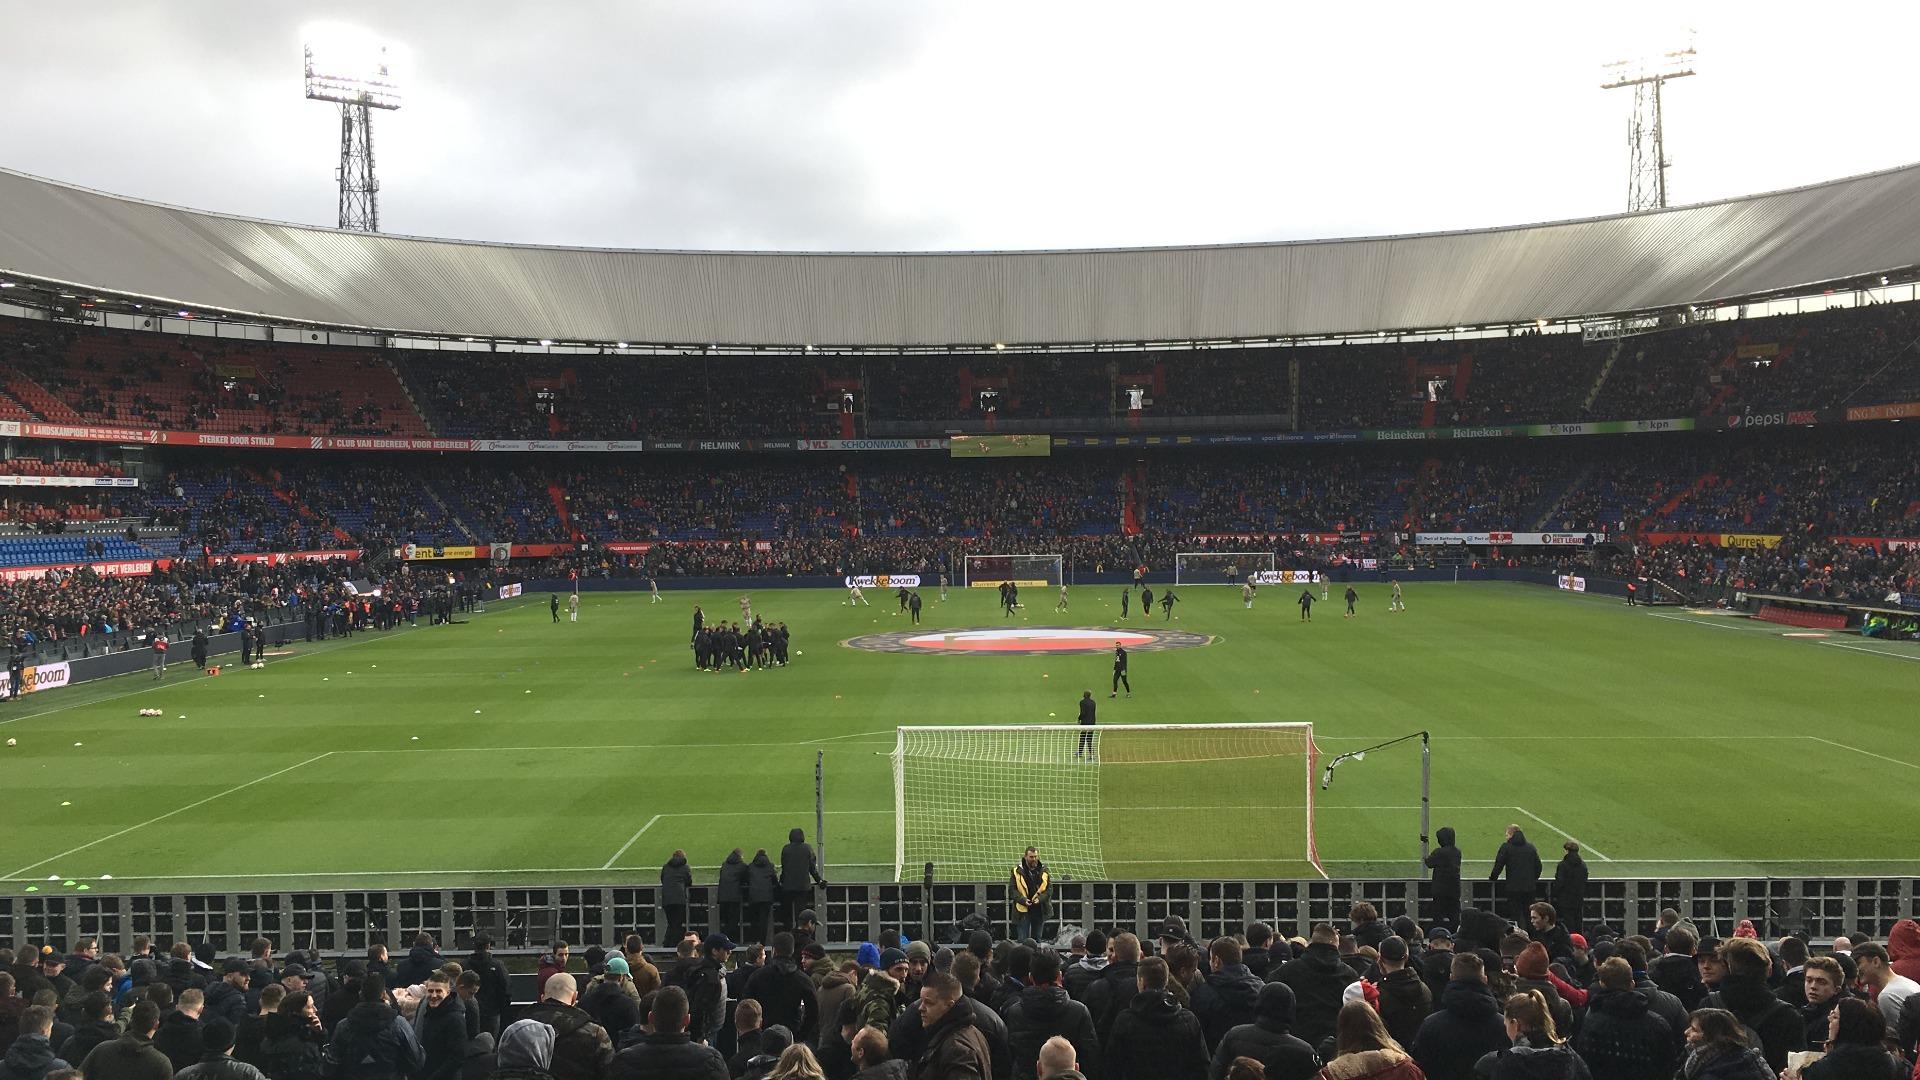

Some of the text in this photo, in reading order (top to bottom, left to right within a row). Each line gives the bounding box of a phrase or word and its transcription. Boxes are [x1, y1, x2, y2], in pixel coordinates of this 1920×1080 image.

[1850, 409, 1868, 419] ING
[1886, 407, 1904, 417] ING
[1745, 412, 1784, 427] pepsi
[1562, 424, 1581, 434] kpn
[1650, 421, 1669, 430] kpn
[33, 425, 89, 438] LANDSKAMPIOEN
[1377, 431, 1425, 440] Heineken
[1453, 428, 1501, 438] Heineken
[199, 434, 275, 446] STERKER DOOR STRIJD
[336, 439, 355, 448] CLUB
[357, 439, 371, 448] VAN
[412, 440, 431, 449] VOOR
[433, 440, 469, 449] IEDEREEN
[812, 440, 829, 449] VLS
[841, 440, 908, 449] SCHOONMAAK
[916, 440, 931, 448] VLS
[700, 441, 740, 450] HELMINK
[1728, 535, 1765, 548] Qurrent
[120, 562, 152, 574] VERLEDEN
[848, 576, 916, 587] Kwekkeboom
